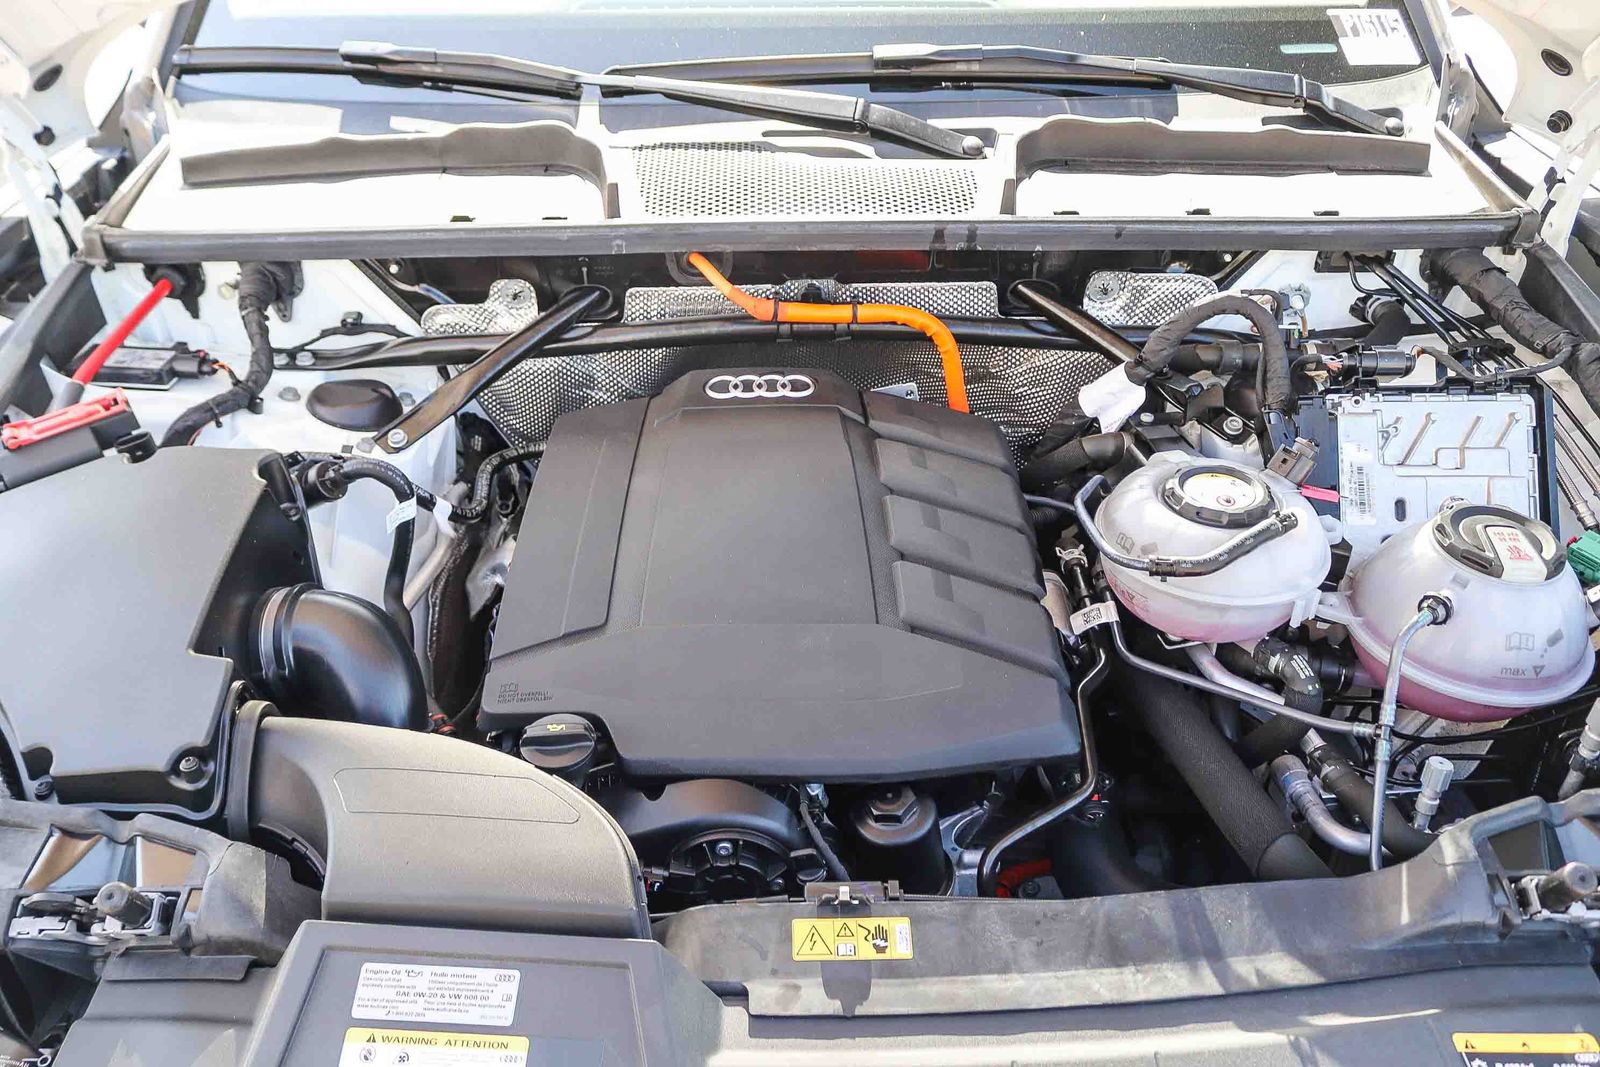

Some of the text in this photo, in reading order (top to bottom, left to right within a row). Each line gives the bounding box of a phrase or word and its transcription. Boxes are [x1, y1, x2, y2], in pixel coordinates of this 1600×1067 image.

[1500, 666, 1527, 677] max
[365, 967, 401, 976] Engine Oil
[381, 1034, 509, 1050] WARNING ATTENTION
